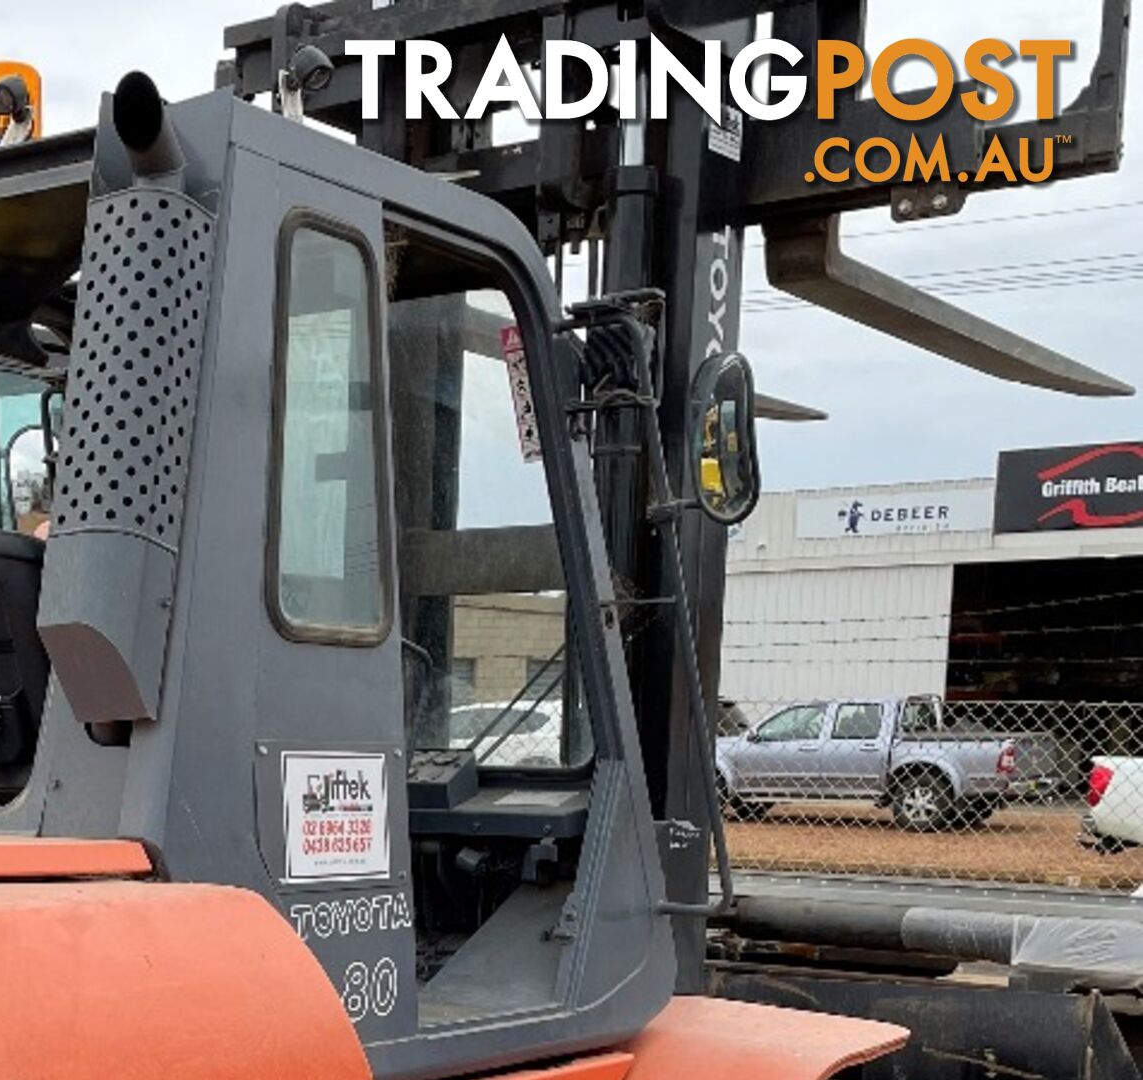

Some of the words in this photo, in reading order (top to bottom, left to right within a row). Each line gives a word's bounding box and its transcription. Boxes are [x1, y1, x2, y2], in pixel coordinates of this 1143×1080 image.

[1041, 477, 1100, 497] Griffith
[291, 894, 412, 941] TOYOTA
[342, 957, 398, 1022] 80
